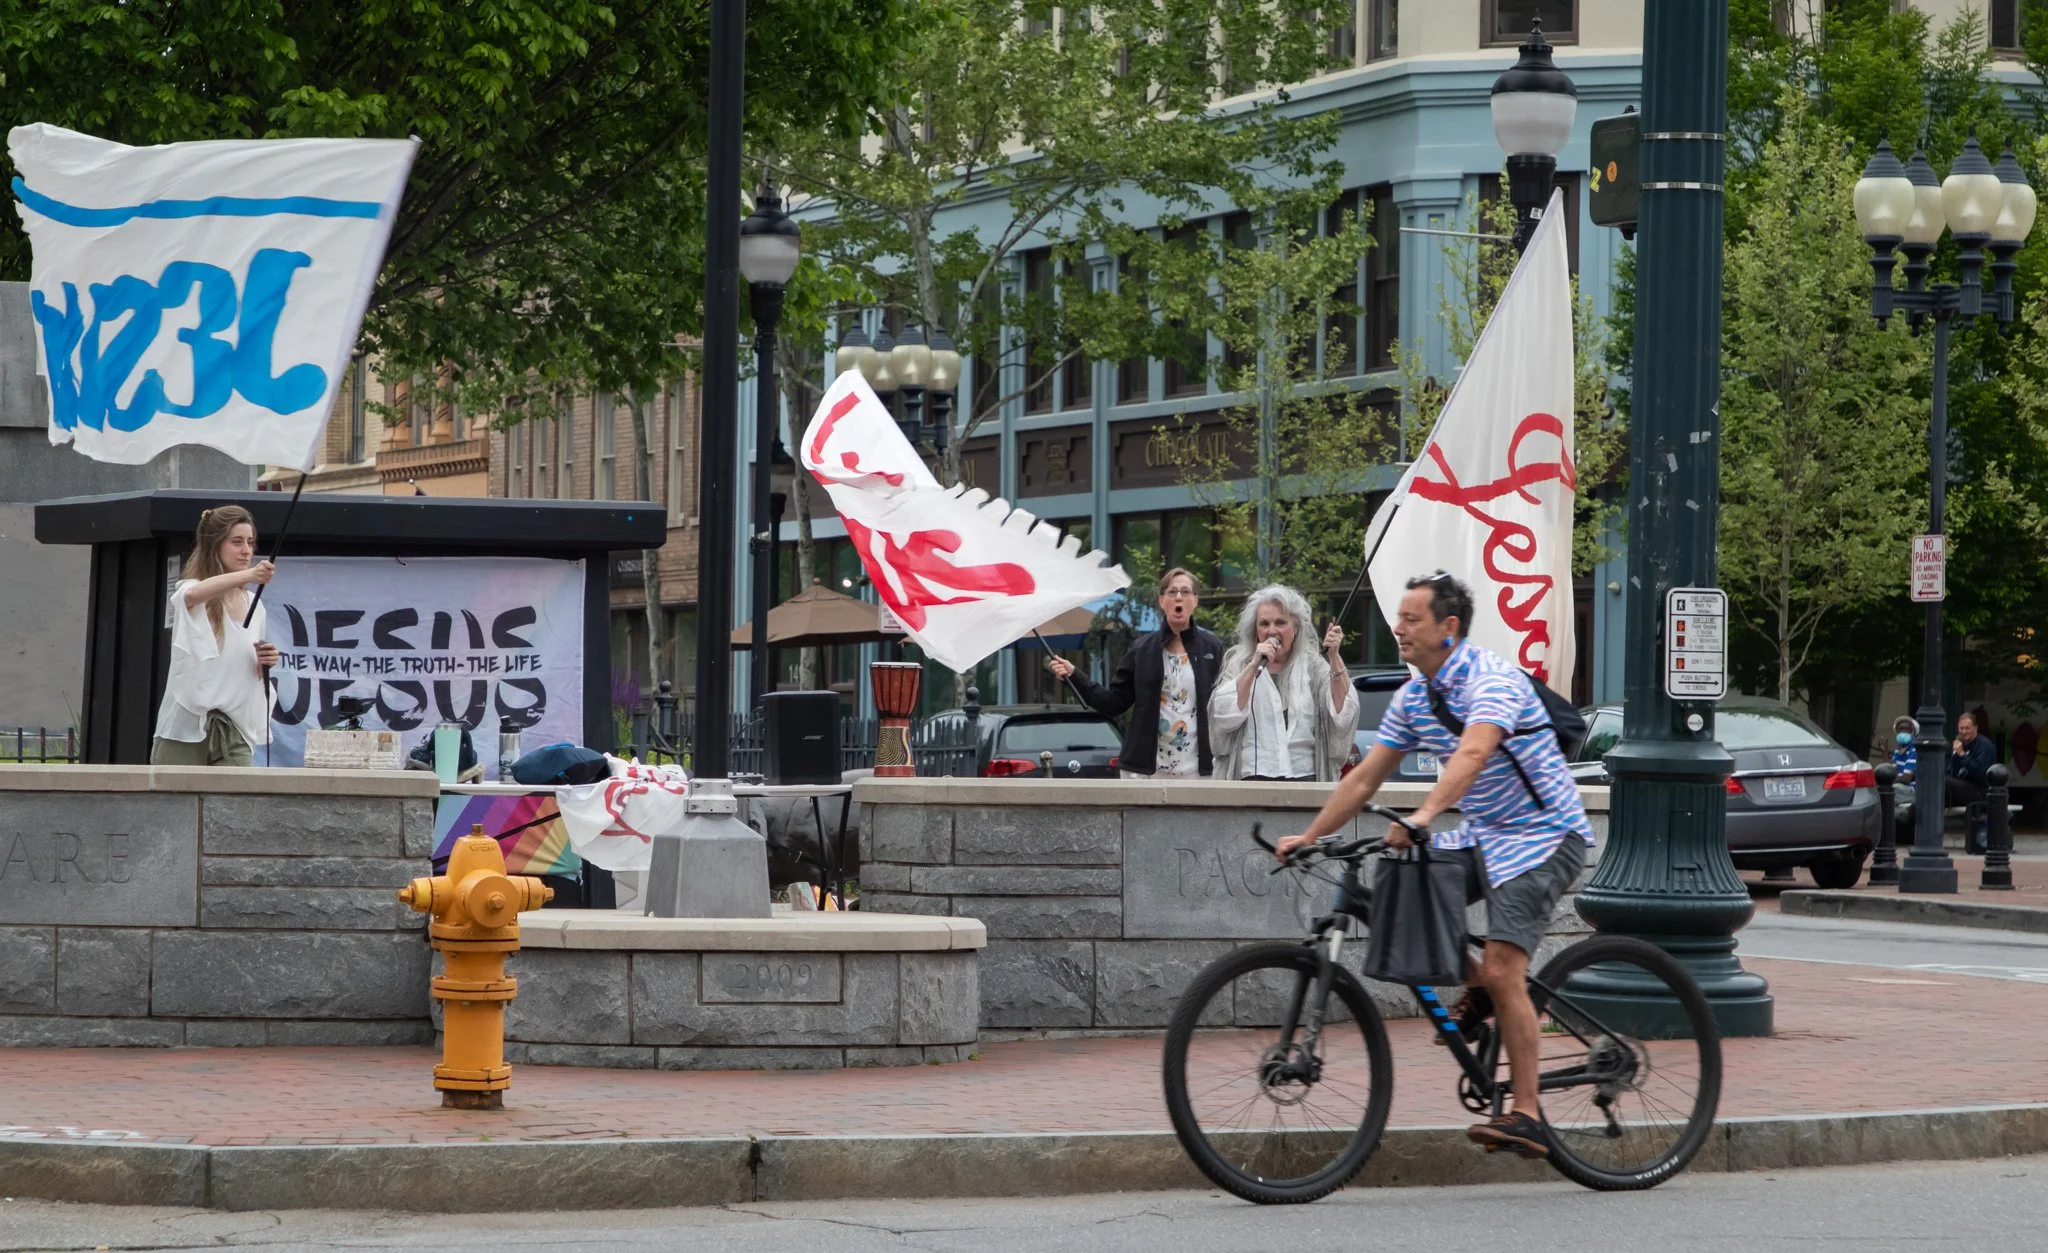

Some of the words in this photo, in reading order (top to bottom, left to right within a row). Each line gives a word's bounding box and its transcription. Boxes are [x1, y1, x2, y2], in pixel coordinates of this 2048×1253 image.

[1409, 413, 1576, 684] Jesu
[1923, 539, 1934, 551] NO
[1915, 551, 1942, 563] PARKING
[1923, 564, 1942, 573] MINUTE
[1917, 573, 1939, 581] LOADING
[1921, 582, 1935, 590] ZONE
[279, 651, 308, 671] THE
[505, 653, 543, 673] LIFE
[732, 962, 813, 990] 2009
[1634, 1155, 1680, 1181] KENDA
